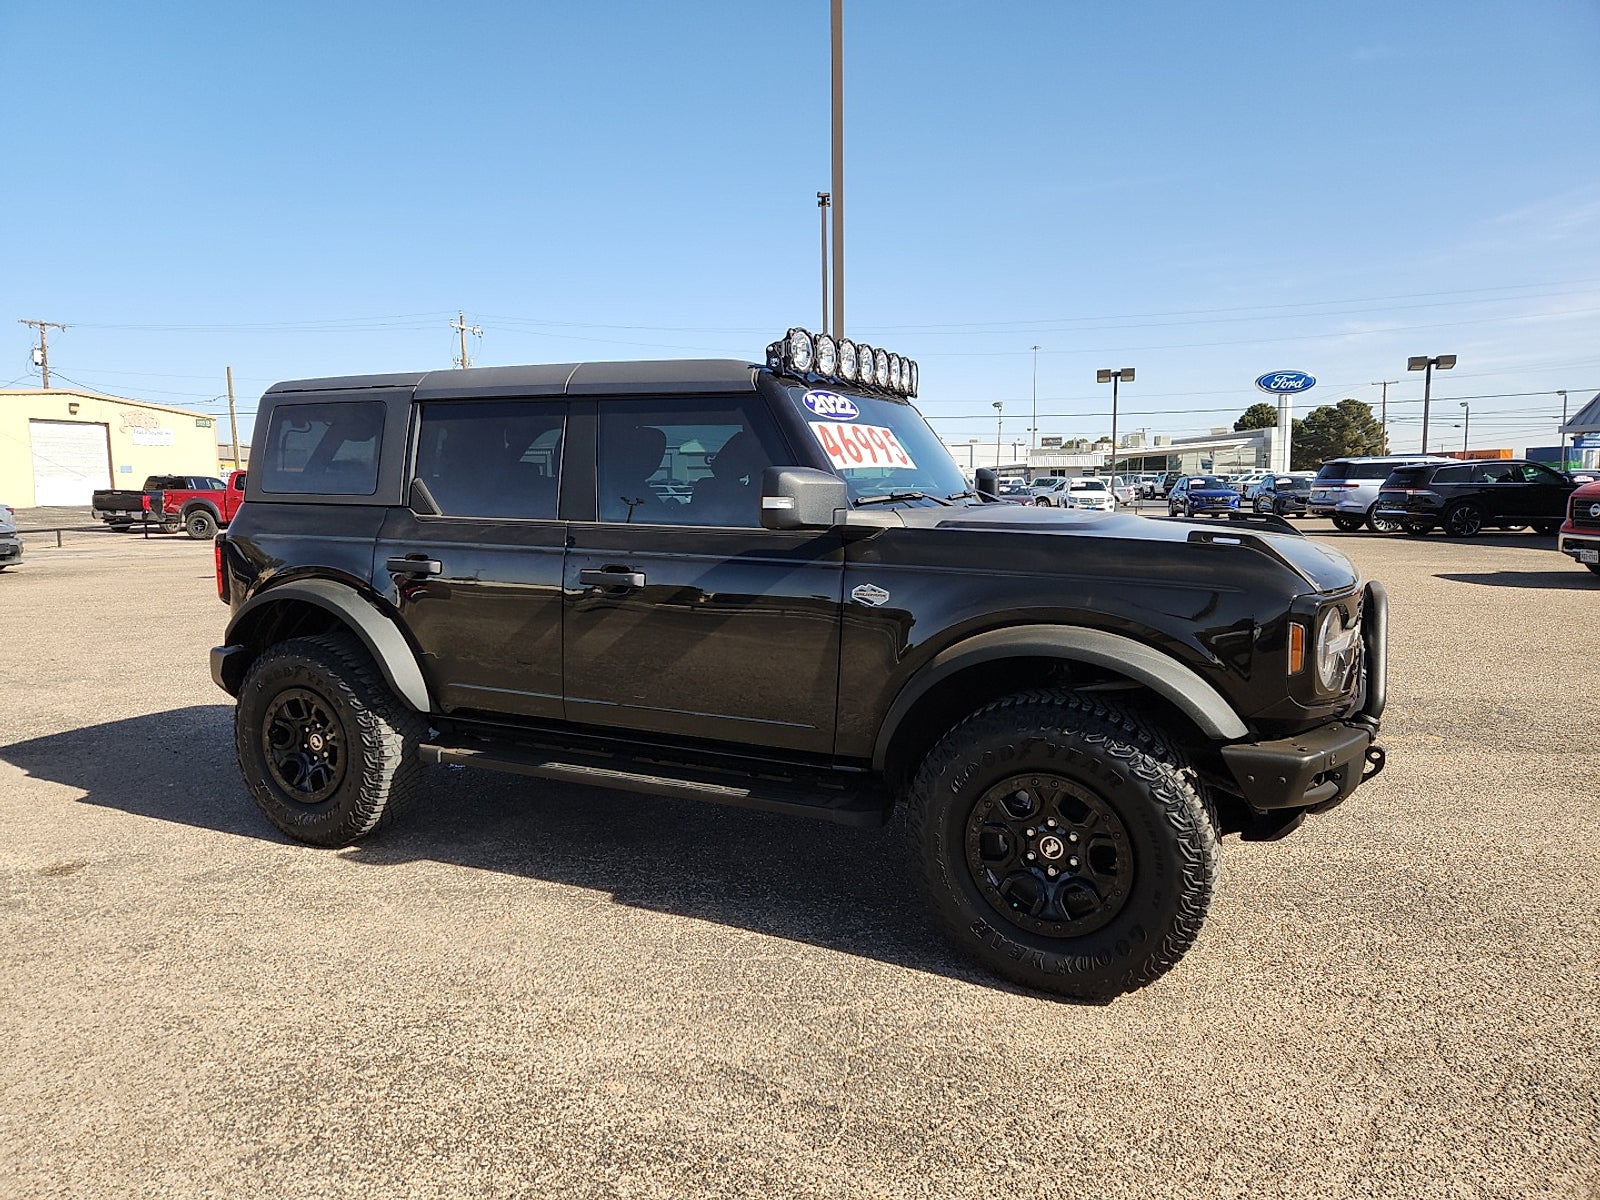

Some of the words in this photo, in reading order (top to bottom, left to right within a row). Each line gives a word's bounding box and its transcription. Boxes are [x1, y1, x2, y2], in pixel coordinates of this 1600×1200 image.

[1271, 375, 1305, 389] Ford
[808, 394, 857, 416] 2022
[817, 424, 908, 465] 46995
[950, 738, 1126, 794] GOODYEAR
[968, 916, 1149, 977] GOODYEAR
